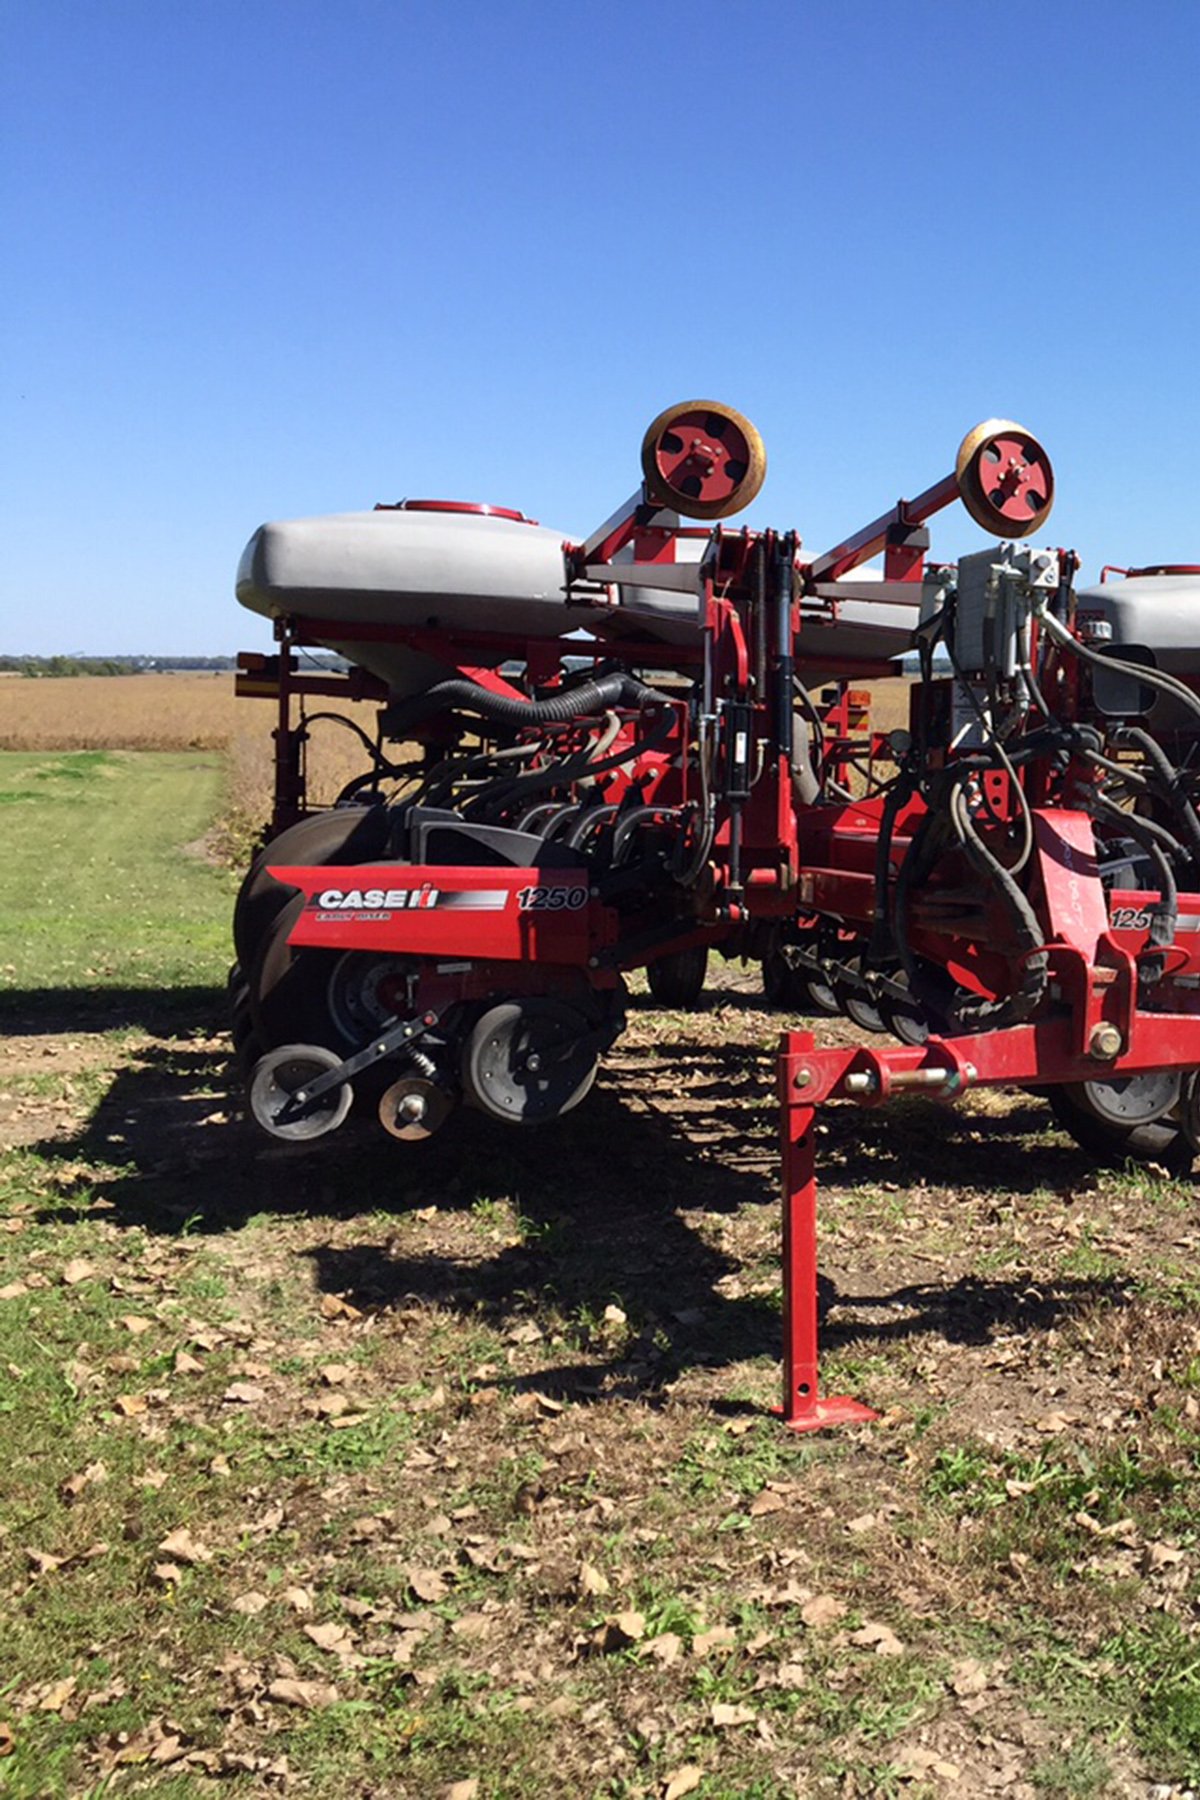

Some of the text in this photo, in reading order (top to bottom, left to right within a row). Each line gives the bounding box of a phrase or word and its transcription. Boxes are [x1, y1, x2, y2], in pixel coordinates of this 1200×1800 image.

[318, 889, 407, 909] CASE
[516, 886, 589, 910] 1250
[1110, 908, 1156, 931] 125
